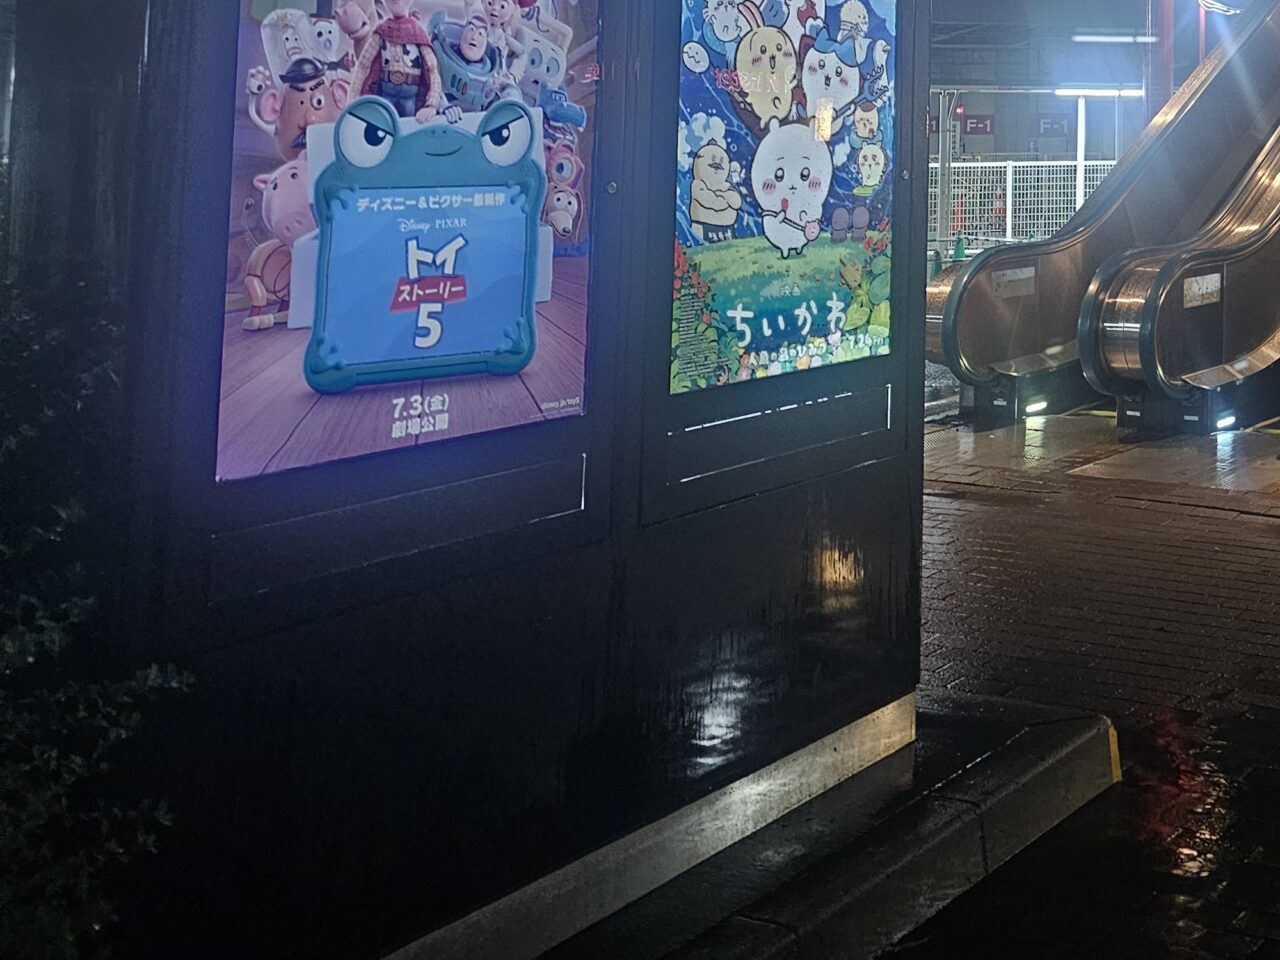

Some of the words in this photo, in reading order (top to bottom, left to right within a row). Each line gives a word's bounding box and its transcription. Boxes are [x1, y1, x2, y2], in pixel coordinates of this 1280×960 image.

[966, 119, 991, 132] F-1
[1039, 118, 1068, 134] F-1
[435, 218, 467, 229] PIXAR
[405, 233, 468, 281] トイ
[398, 281, 464, 302] ストーリー
[413, 302, 444, 349] 5
[727, 291, 847, 348] ちいかわ
